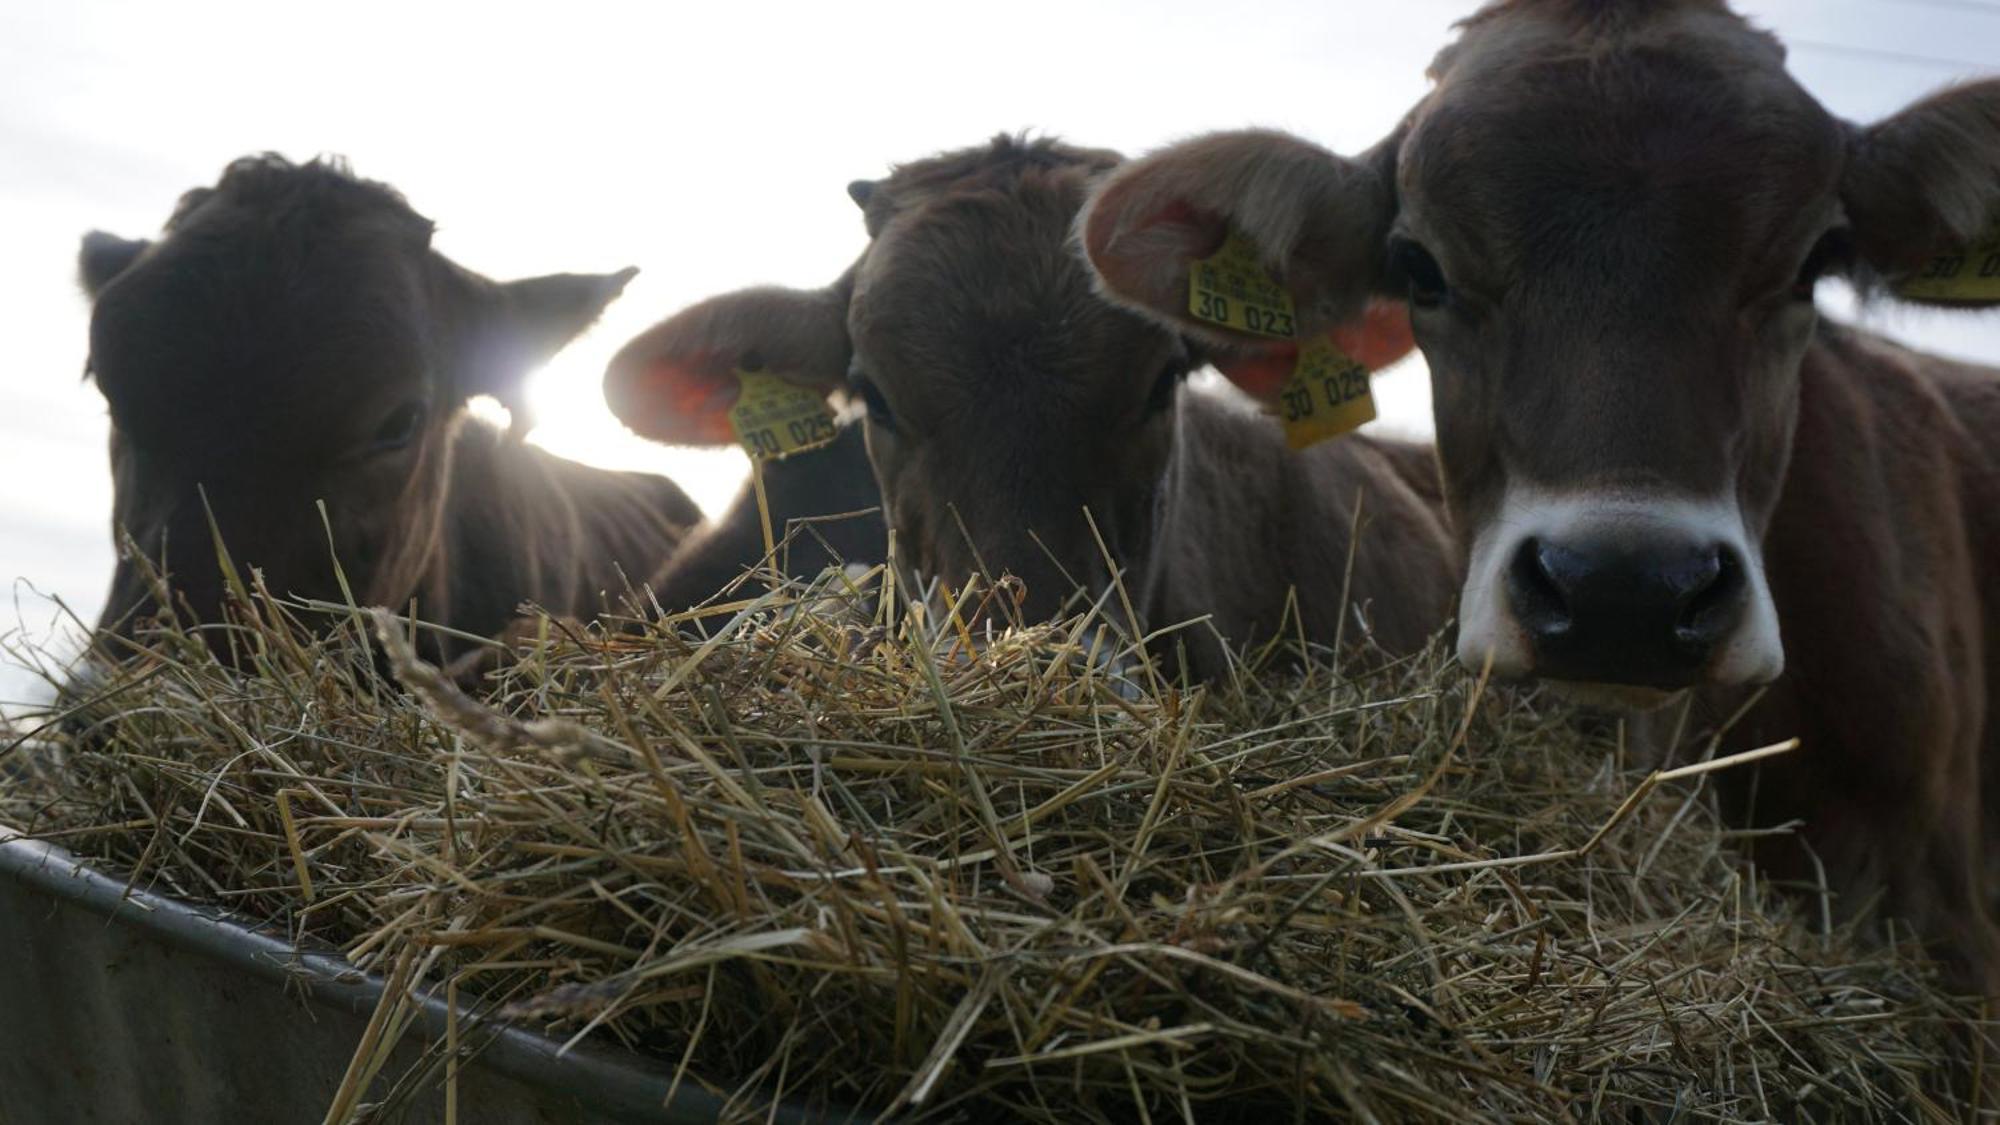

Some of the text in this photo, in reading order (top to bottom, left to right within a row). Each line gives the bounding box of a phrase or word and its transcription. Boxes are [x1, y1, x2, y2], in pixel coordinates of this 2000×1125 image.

[1198, 291, 1294, 335] 30 023
[1282, 387, 1313, 422] 30
[1325, 364, 1368, 406] 025
[788, 413, 836, 445] 025
